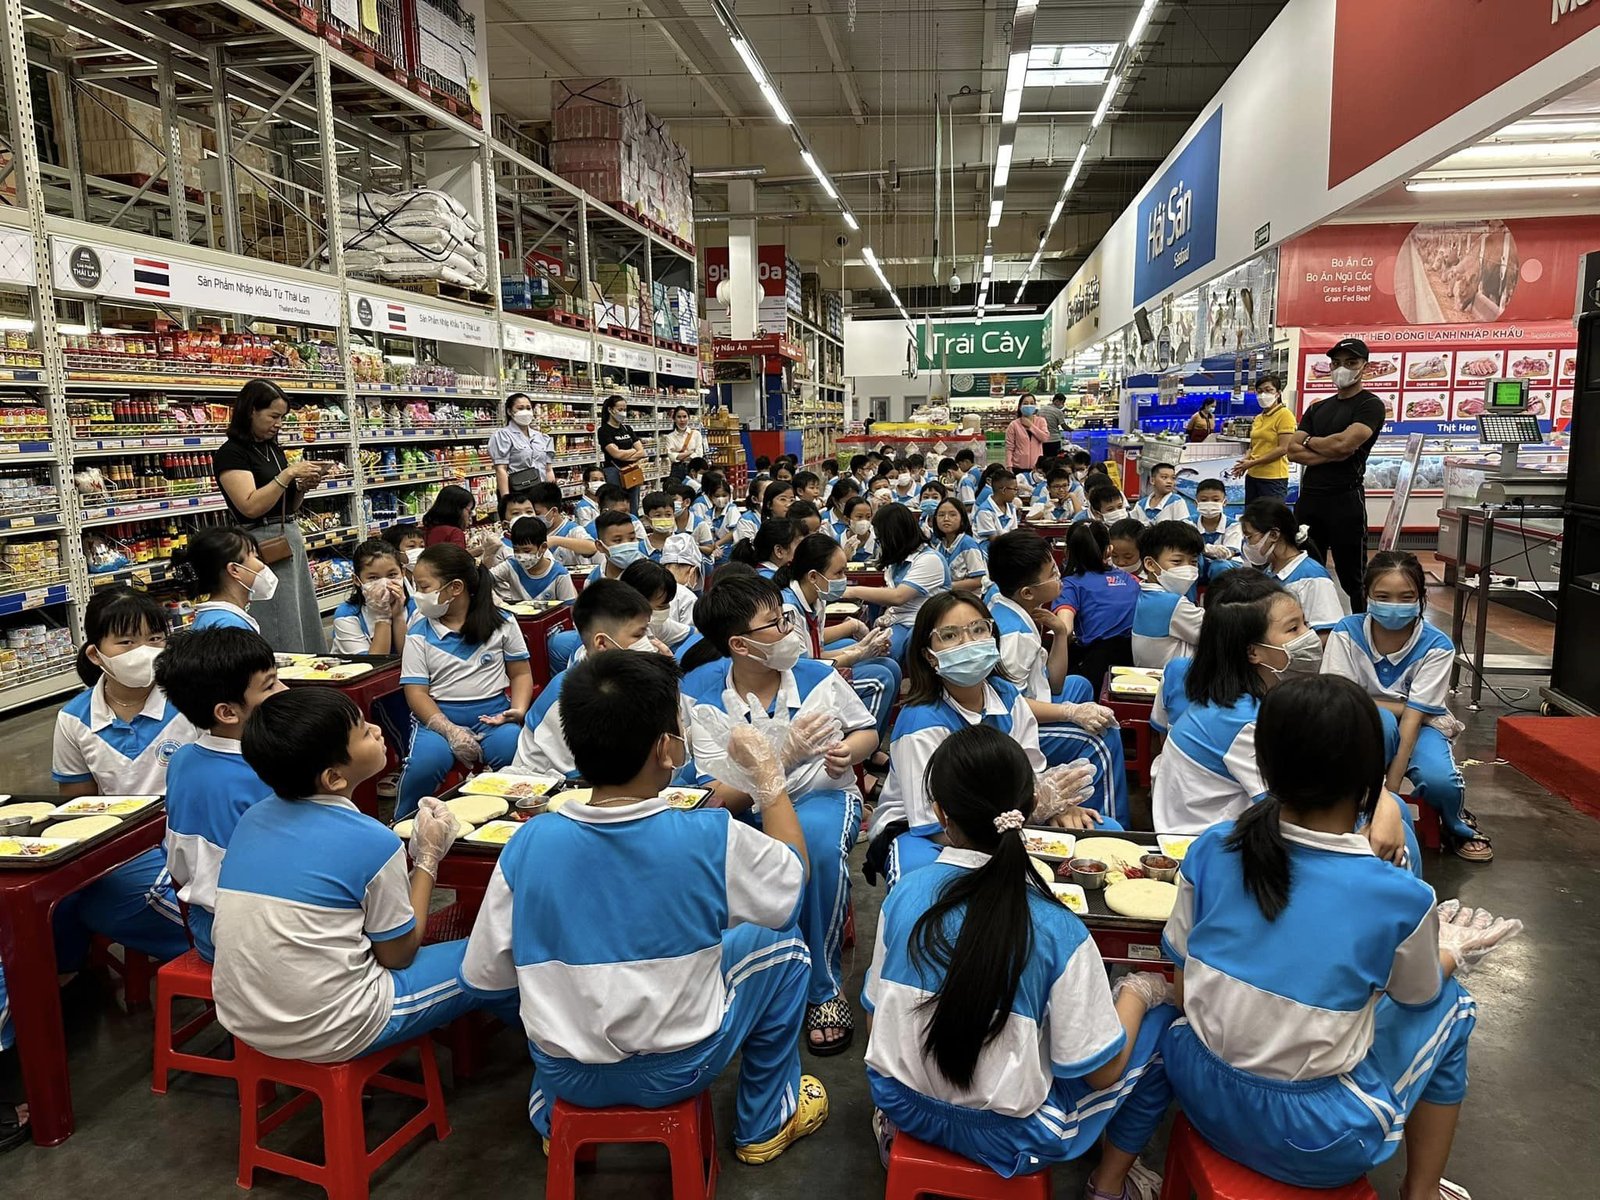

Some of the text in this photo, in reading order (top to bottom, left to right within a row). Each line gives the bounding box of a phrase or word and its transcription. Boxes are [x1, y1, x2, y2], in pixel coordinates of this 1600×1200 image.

[298, 293, 310, 303] Lan
[932, 332, 974, 354] Trái
[982, 330, 1030, 360] Cây
[1437, 423, 1477, 434] Thịt Heo
